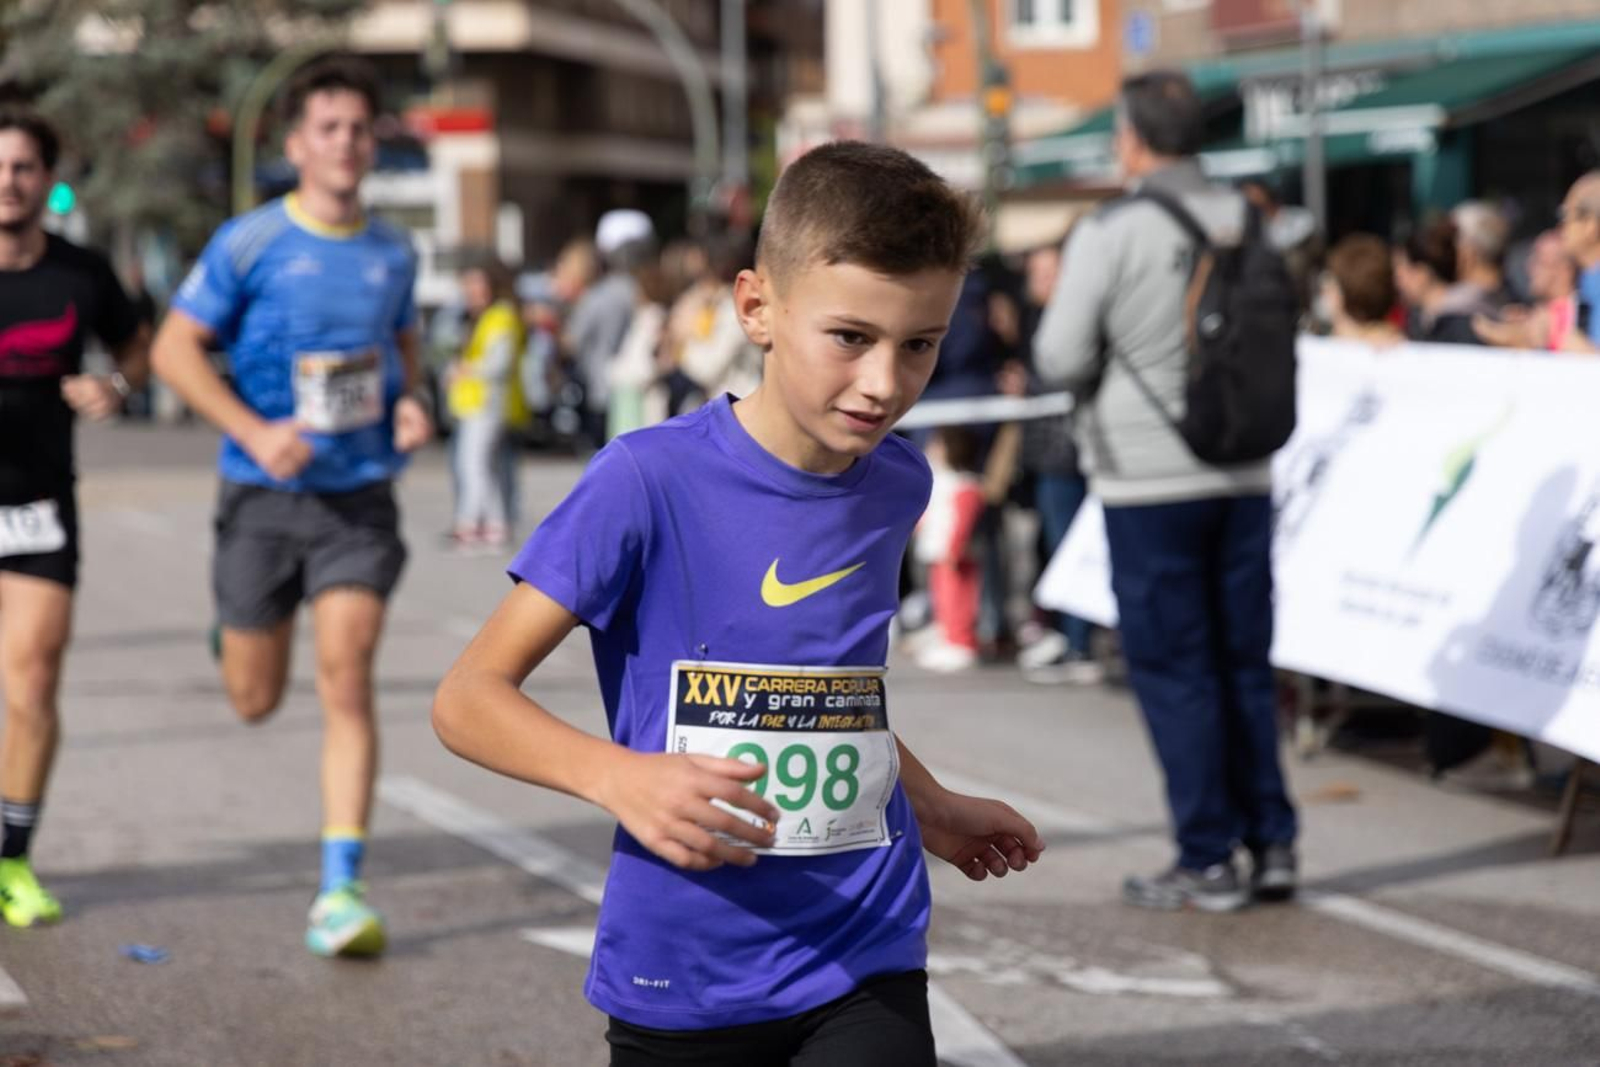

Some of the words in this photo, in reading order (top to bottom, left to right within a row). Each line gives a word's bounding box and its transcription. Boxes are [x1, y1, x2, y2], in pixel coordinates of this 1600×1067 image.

[683, 672, 742, 707] XXV
[745, 677, 828, 694] CARRERA
[744, 692, 757, 709] y
[767, 693, 815, 710] gran
[708, 710, 737, 726] POR
[737, 712, 759, 728] LA
[797, 715, 817, 730] LA
